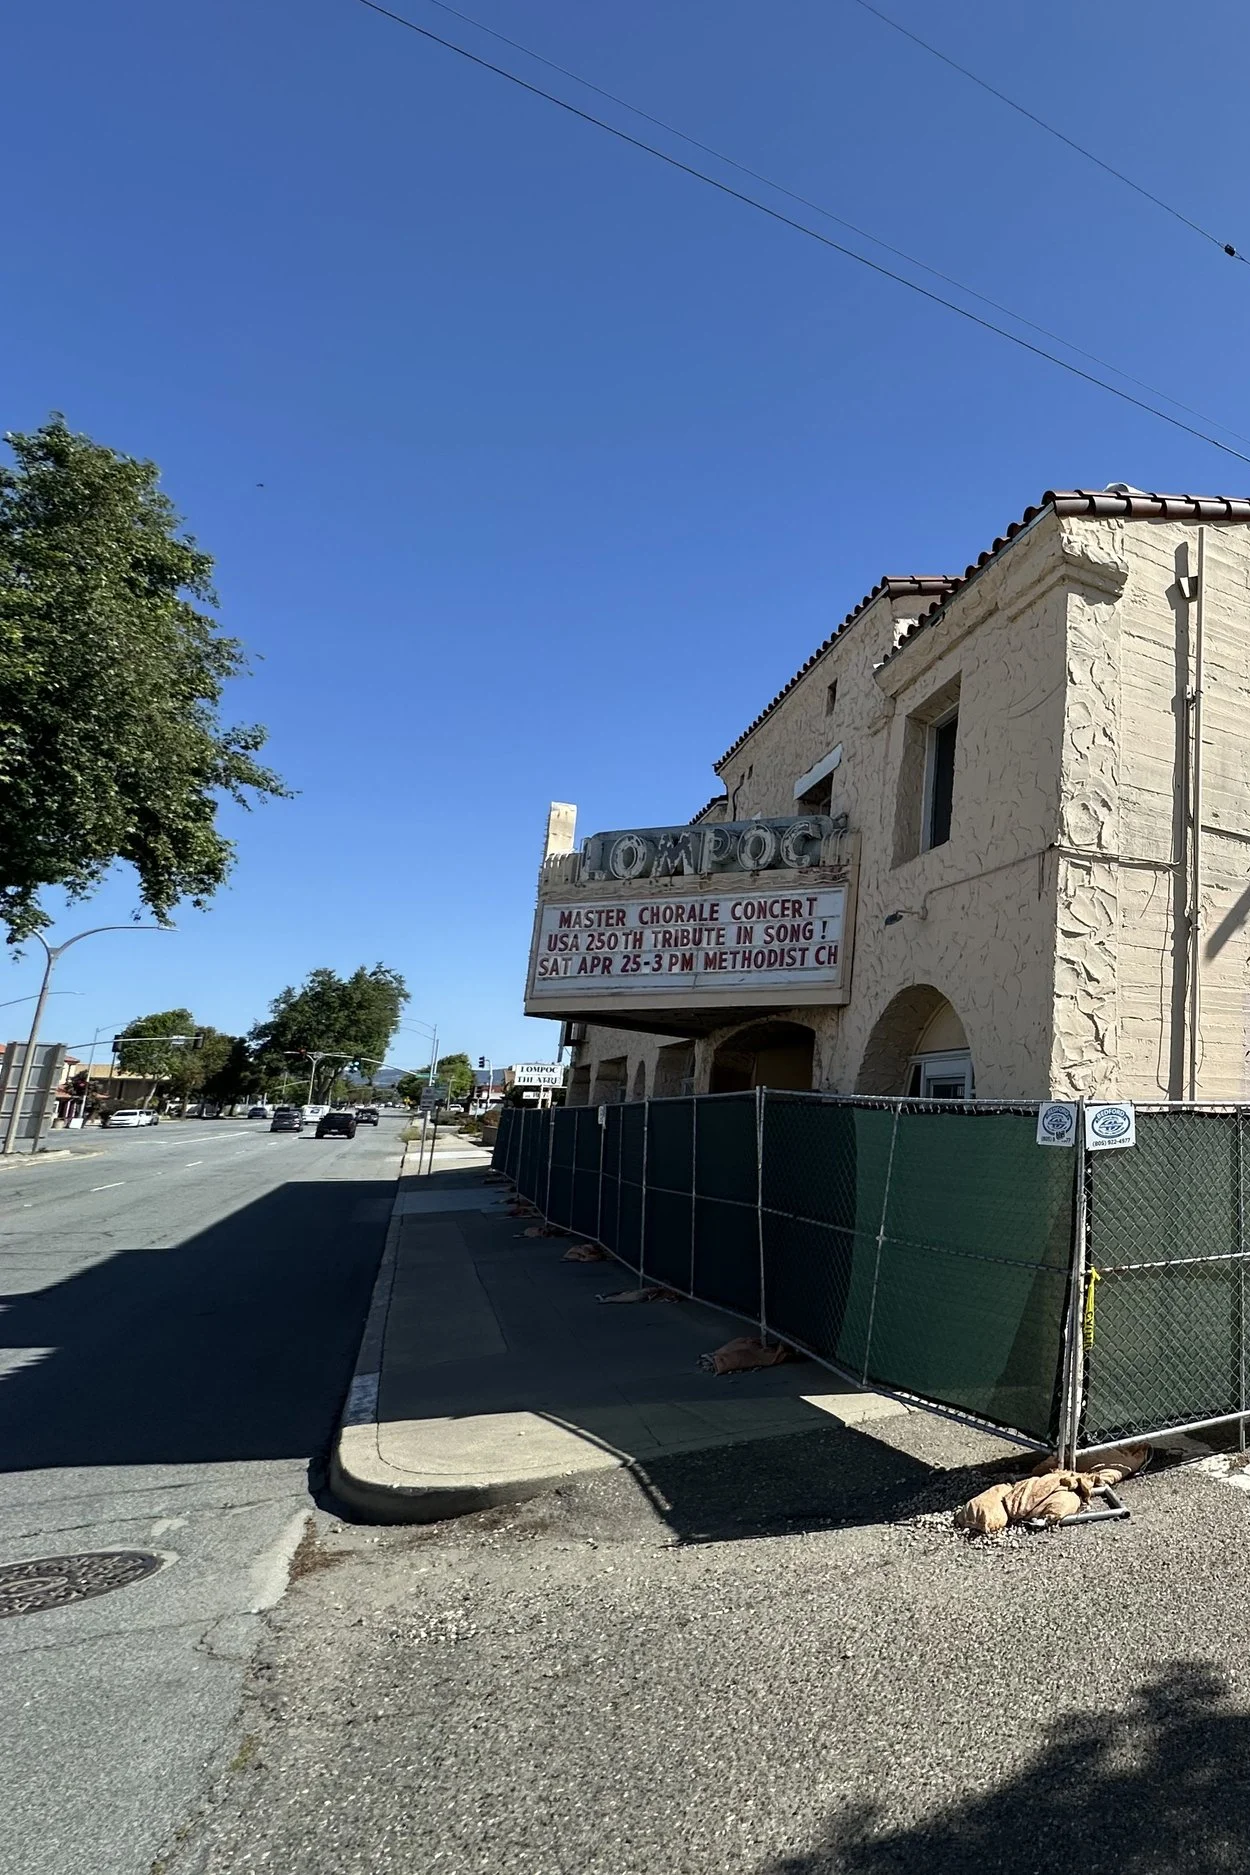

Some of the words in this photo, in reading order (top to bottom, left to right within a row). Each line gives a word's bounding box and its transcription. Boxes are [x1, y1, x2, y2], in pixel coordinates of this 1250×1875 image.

[578, 821, 823, 881] LOMPOC
[558, 908, 627, 929] MASTER
[638, 903, 720, 926] CHORALE
[730, 896, 818, 921] CONCERT
[547, 933, 580, 952] USA
[586, 930, 645, 951] 250TH
[652, 926, 726, 948] TRIBUTE
[735, 925, 754, 945] IN
[538, 957, 573, 977] SAT
[577, 955, 613, 975] APR
[620, 953, 663, 973] 25-3
[667, 952, 694, 972] PM
[703, 946, 810, 971] METHODIST
[814, 944, 839, 966] CH
[1096, 1108, 1125, 1119] BEDFORD
